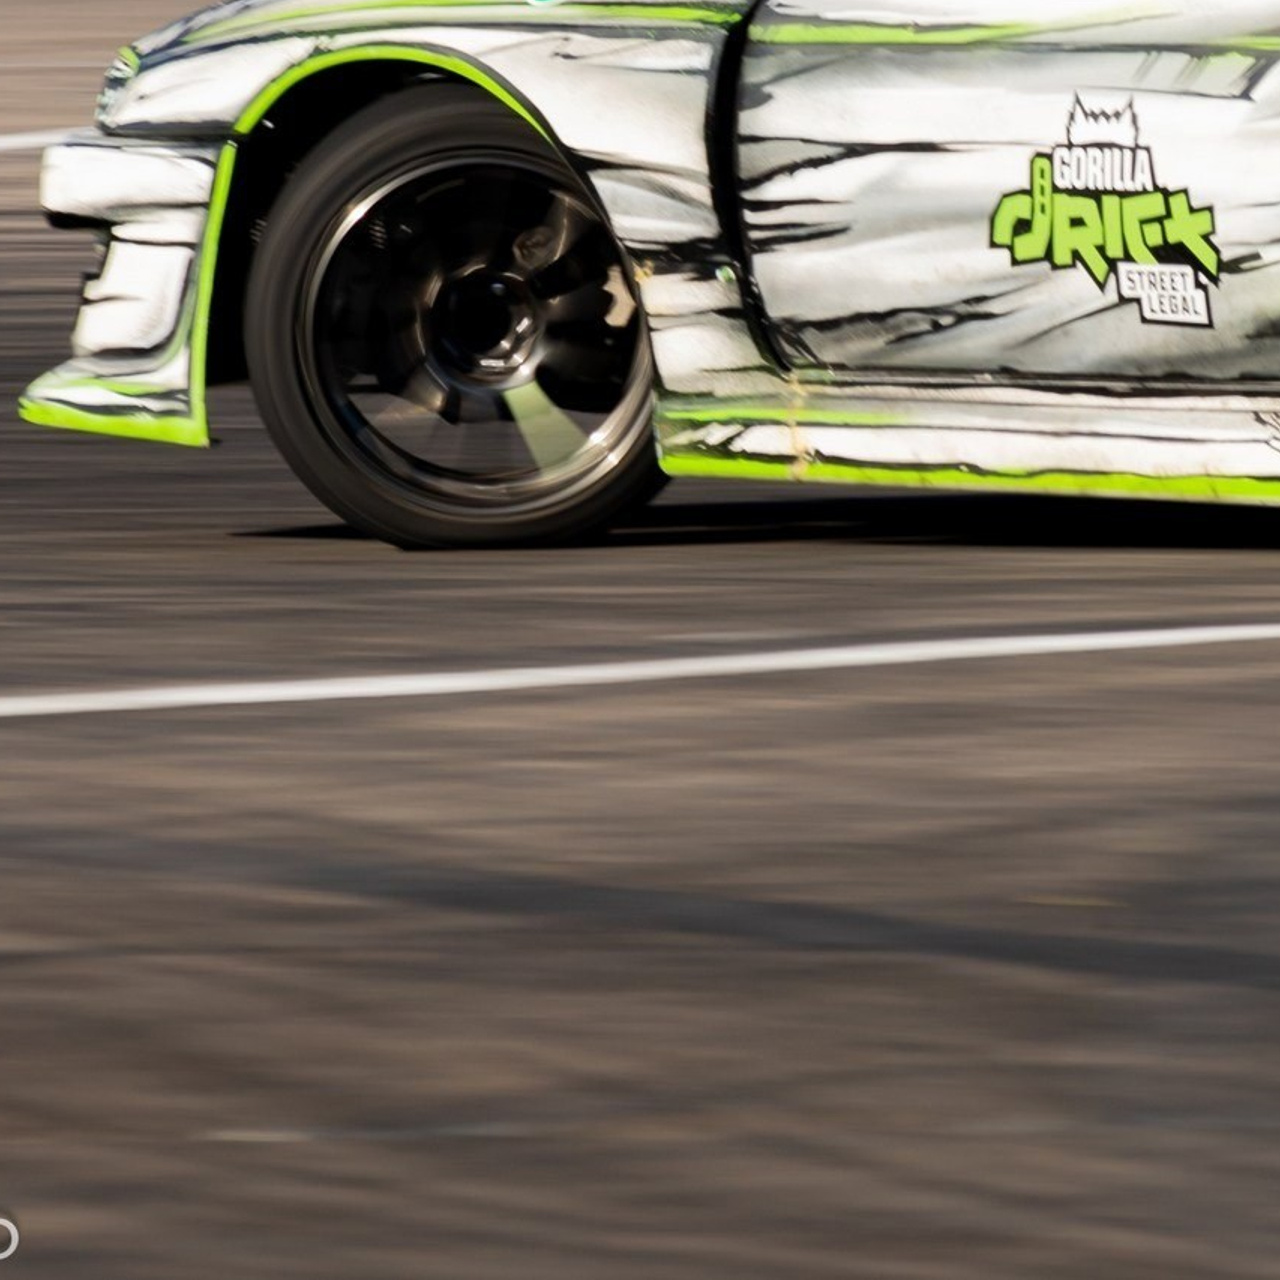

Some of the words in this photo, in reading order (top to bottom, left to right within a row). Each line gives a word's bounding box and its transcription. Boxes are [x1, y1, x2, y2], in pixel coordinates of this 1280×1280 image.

[1053, 146, 1154, 191] GORILLA
[1126, 269, 1189, 293] STREET
[1147, 293, 1202, 316] LEGAL
